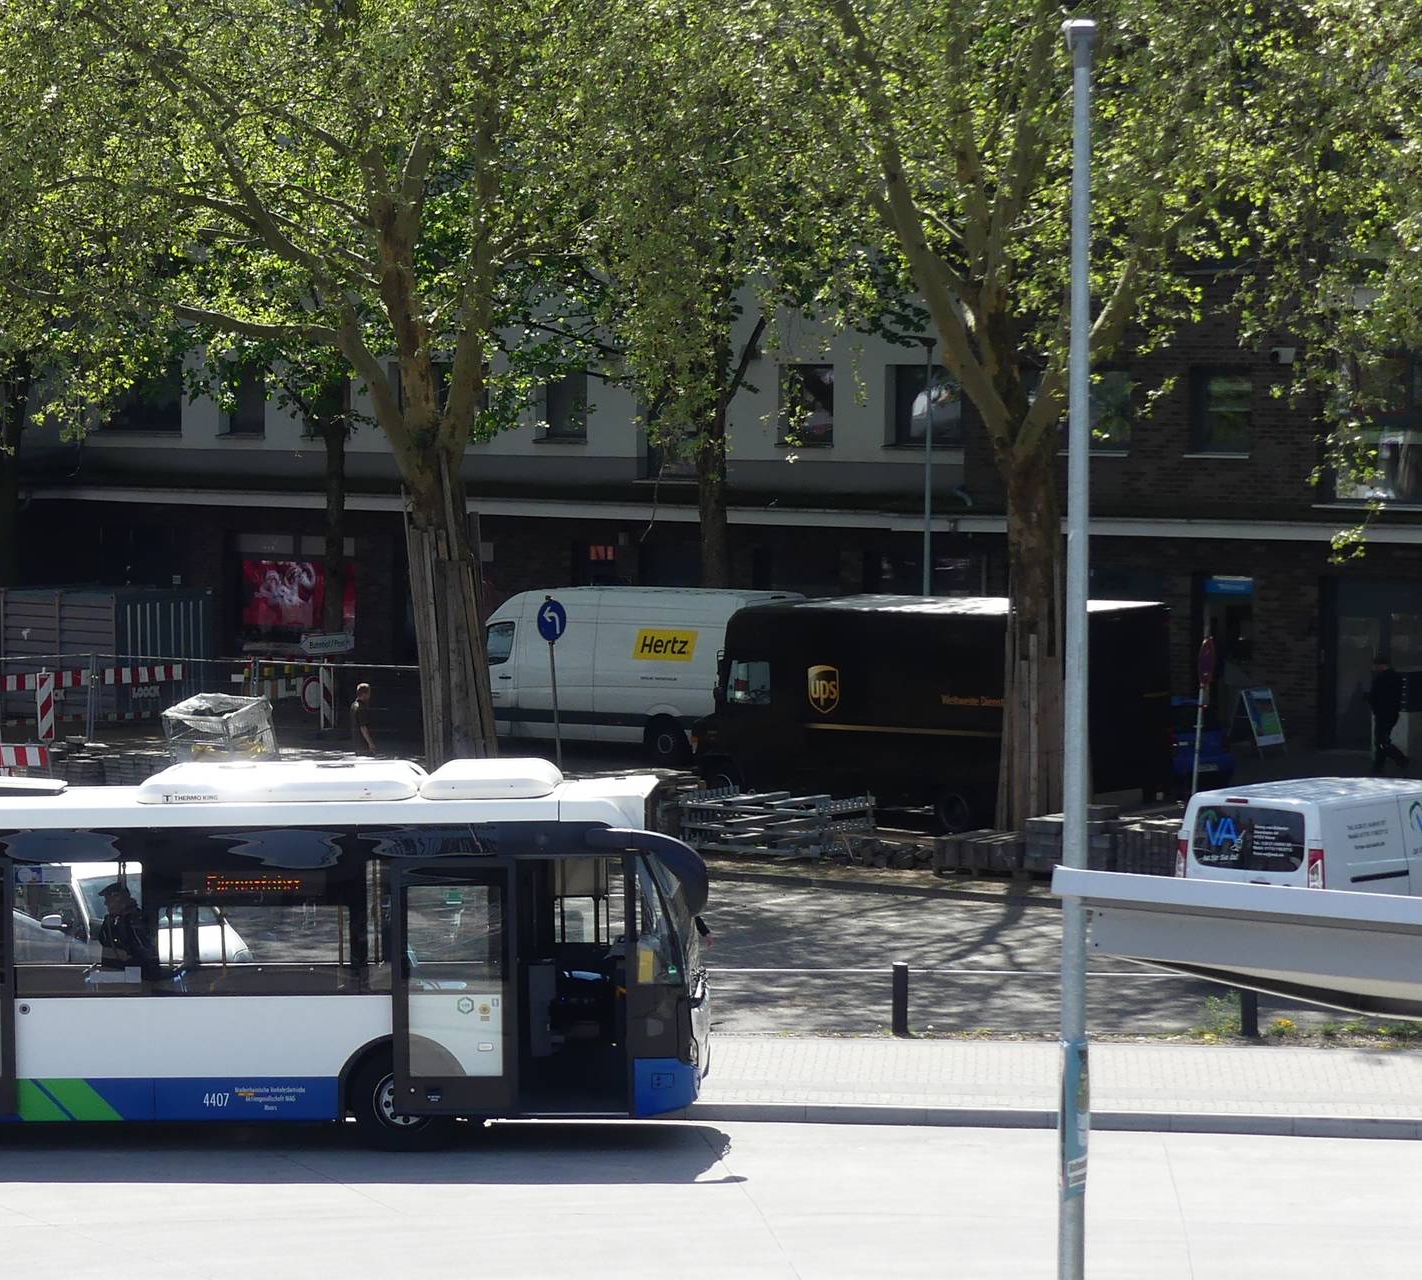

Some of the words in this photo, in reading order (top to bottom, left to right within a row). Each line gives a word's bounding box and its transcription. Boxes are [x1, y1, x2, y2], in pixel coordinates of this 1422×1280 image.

[640, 636, 689, 655] Hertz
[132, 686, 160, 699] LOOCK
[810, 680, 838, 706] ups
[203, 1092, 230, 1107] 4407
